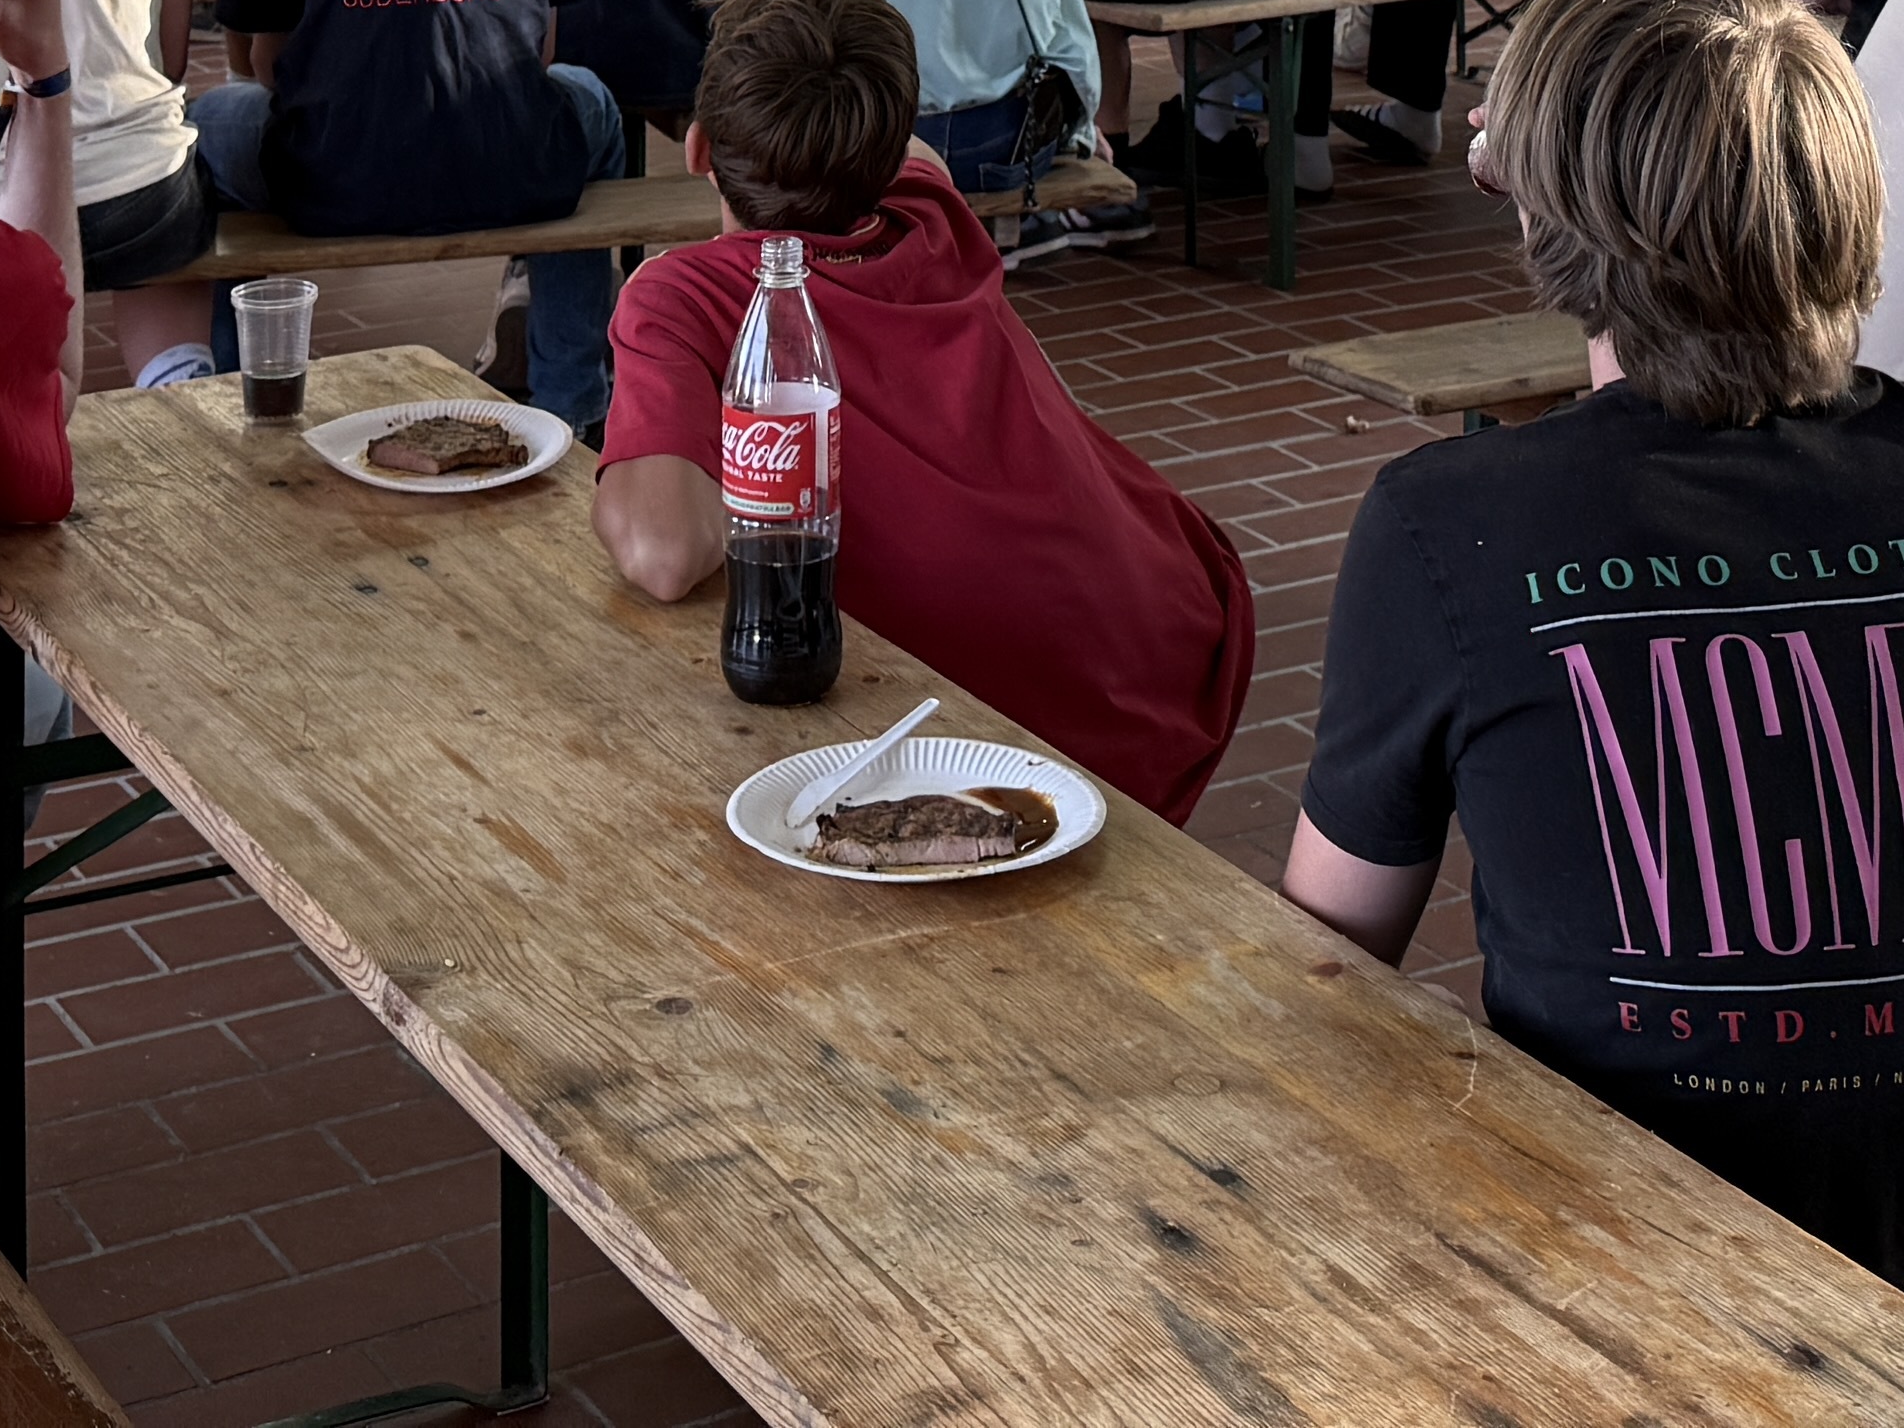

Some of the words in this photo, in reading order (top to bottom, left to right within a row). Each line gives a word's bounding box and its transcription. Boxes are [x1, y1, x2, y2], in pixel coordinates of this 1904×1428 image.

[723, 421, 810, 472] a-Cola
[747, 470, 784, 483] TASTE
[1525, 553, 1732, 605] ICONO
[1673, 1073, 1766, 1095] LONDON
[1801, 1074, 1862, 1093] PARIS
